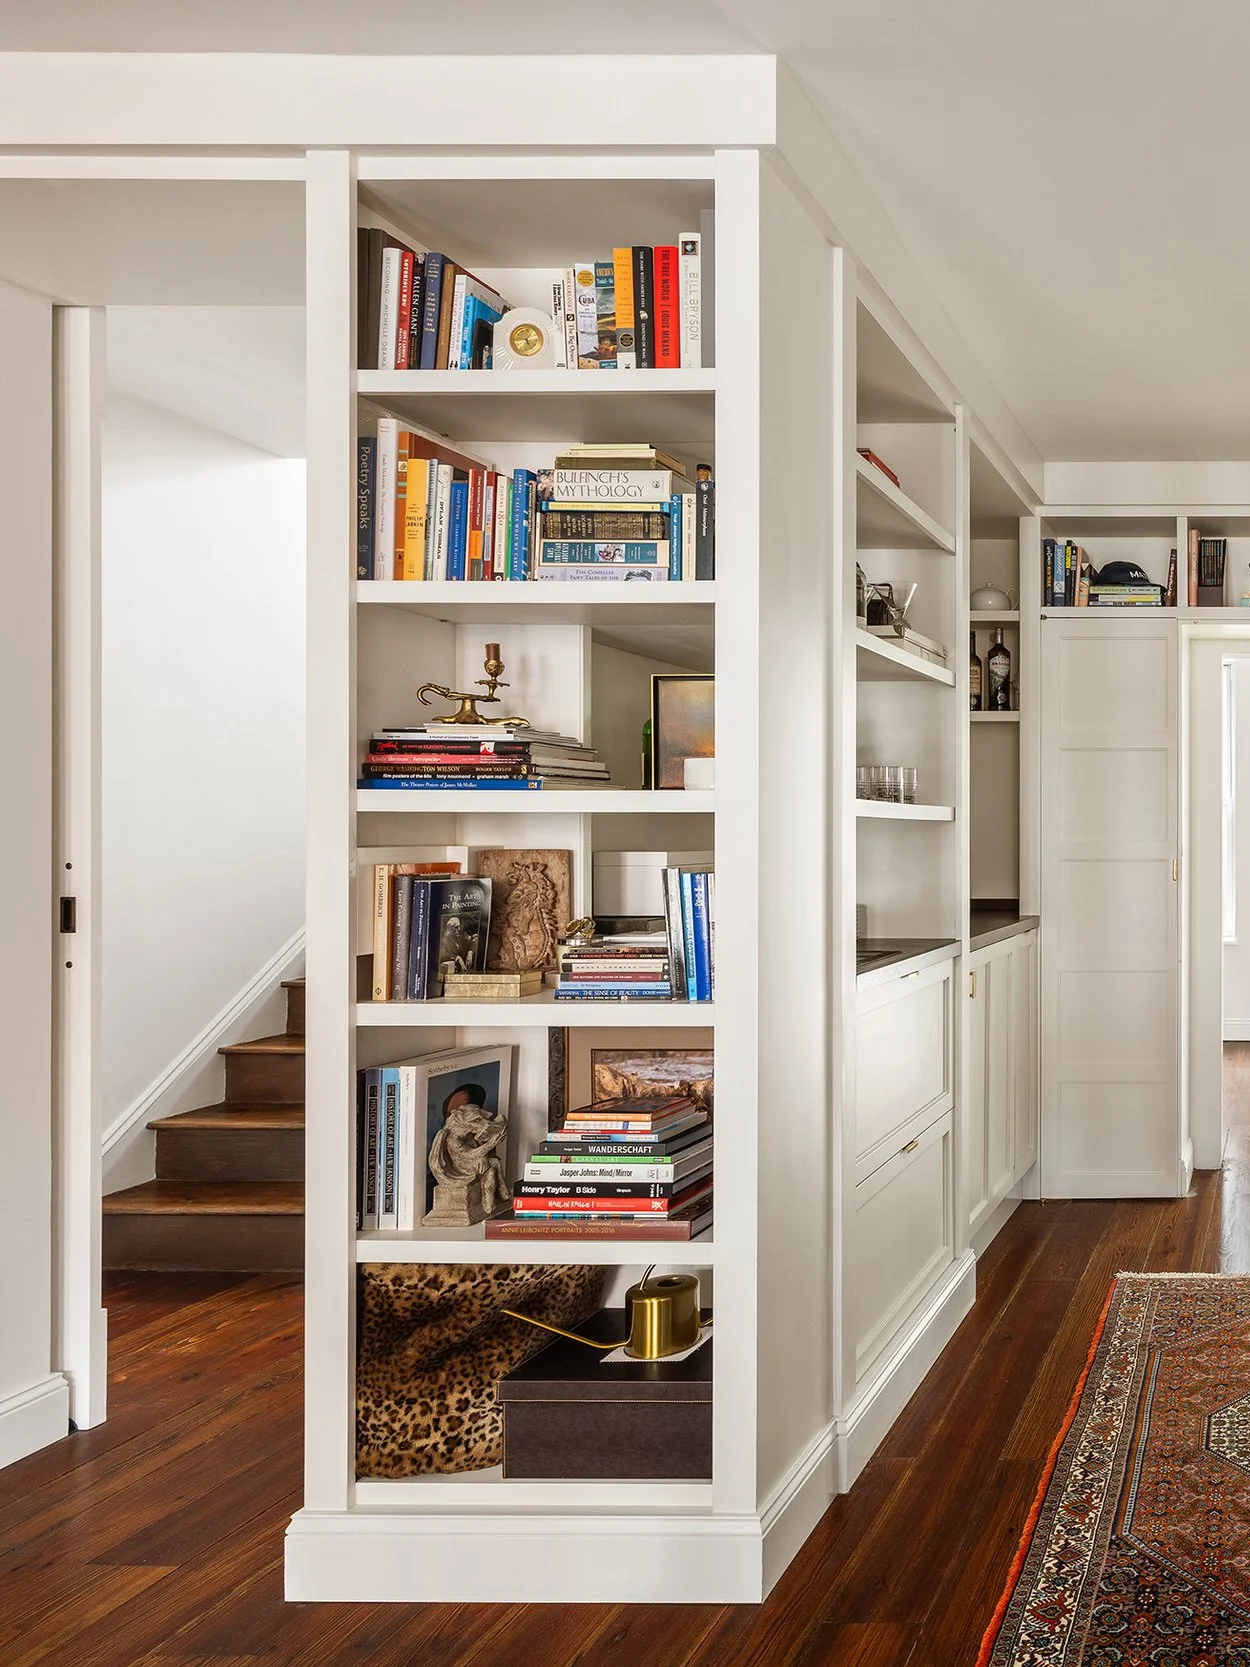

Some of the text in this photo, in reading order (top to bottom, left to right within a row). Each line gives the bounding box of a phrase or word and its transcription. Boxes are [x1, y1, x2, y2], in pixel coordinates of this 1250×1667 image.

[412, 276, 420, 305] FALLEN
[662, 279, 670, 300] WORLD
[579, 294, 595, 306] CUBA
[689, 272, 699, 340] BILL BRYSON
[410, 308, 418, 336] GIANT
[556, 472, 629, 484] BULFINCH'S
[359, 446, 370, 529] Poetry Speaks
[556, 485, 644, 497] MYTHOLOGY
[513, 542, 518, 550] WE
[452, 901, 481, 909] PAINTING
[428, 1064, 457, 1075] Sotheby's
[387, 1098, 395, 1124] HISTORY
[369, 1127, 377, 1136] OF
[387, 1126, 395, 1134] OF
[369, 1138, 377, 1149] ART
[387, 1154, 395, 1166] H.W.
[560, 1168, 633, 1178] Jasper Johns: Mind/Mirror
[368, 1168, 376, 1193] JANSON
[386, 1168, 394, 1192] JANSON
